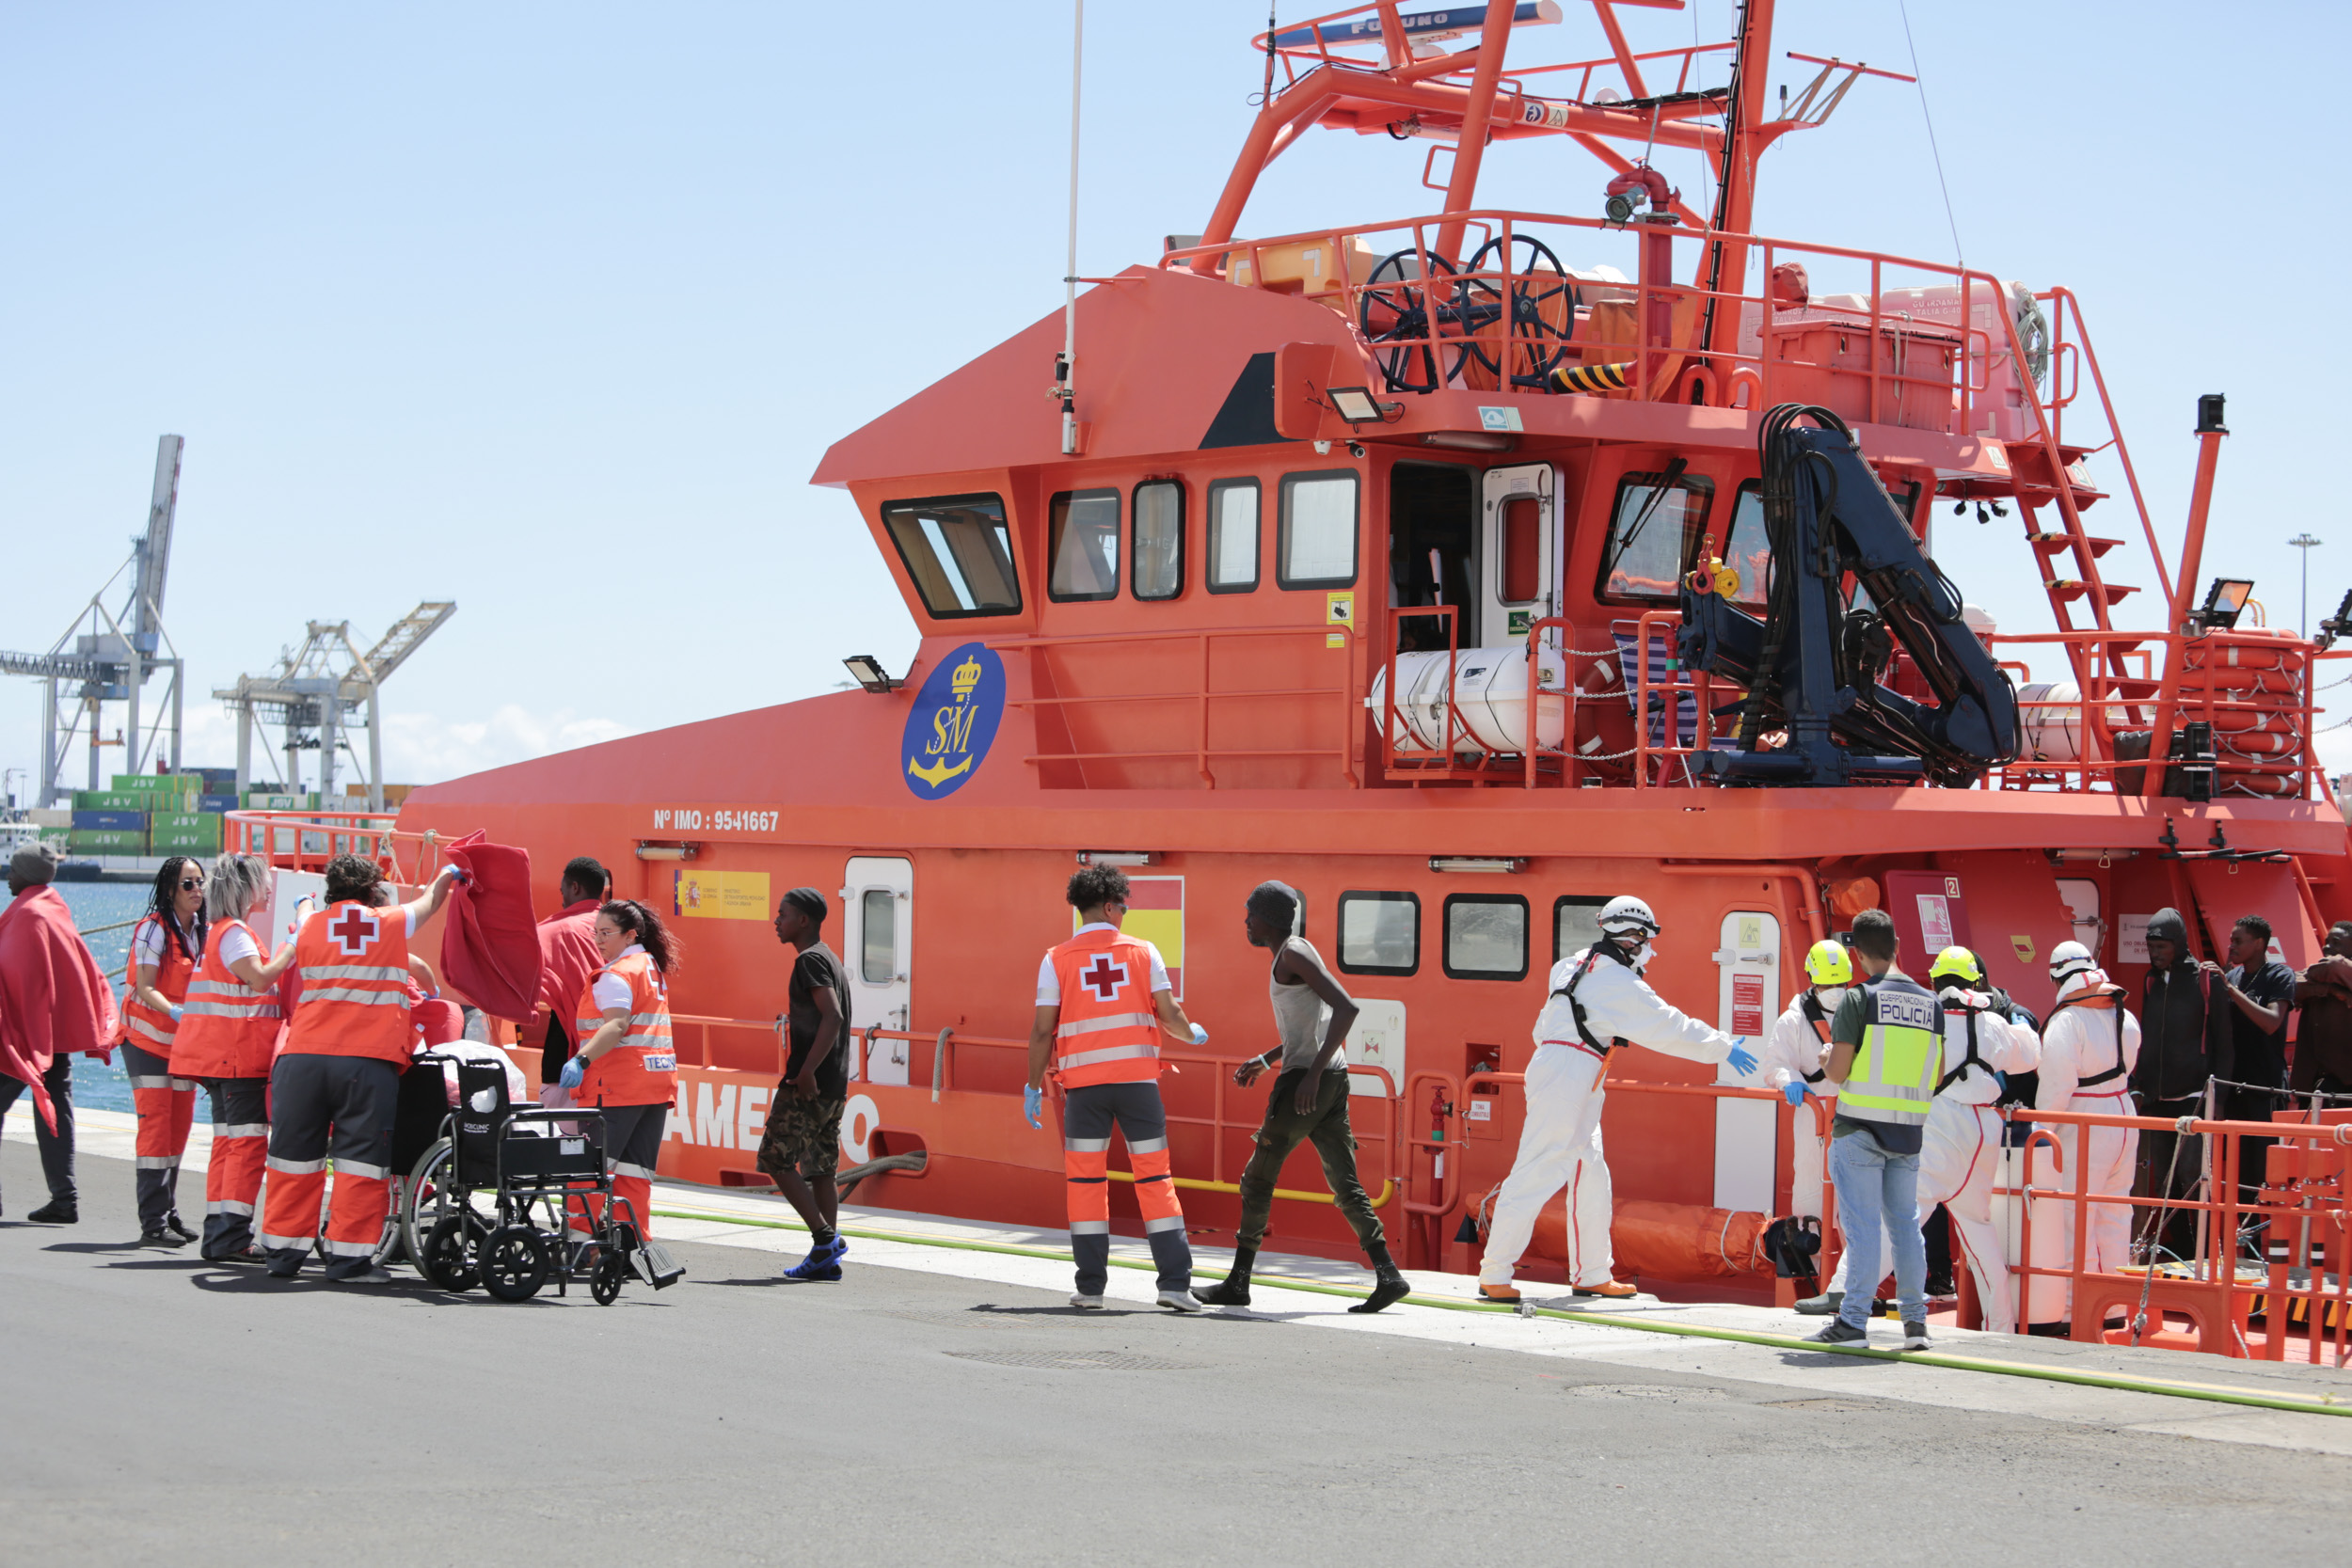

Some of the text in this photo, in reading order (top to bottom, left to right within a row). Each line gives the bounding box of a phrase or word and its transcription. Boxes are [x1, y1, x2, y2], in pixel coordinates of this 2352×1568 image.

[1351, 13, 1449, 35] FUUNO
[1912, 298, 1963, 309] GUARDAMA
[925, 705, 979, 755] SM
[1599, 750, 1624, 768] TLIA
[132, 779, 155, 787] JSV
[103, 797, 132, 806] JSV
[270, 797, 292, 809] JSV
[172, 816, 199, 826] JSV
[675, 810, 702, 831] IMO
[714, 811, 779, 832] 9541667
[95, 834, 120, 845] JSV
[172, 835, 199, 846] JSV
[1948, 880, 1957, 895] 2
[1881, 1004, 1933, 1027] POLICIA
